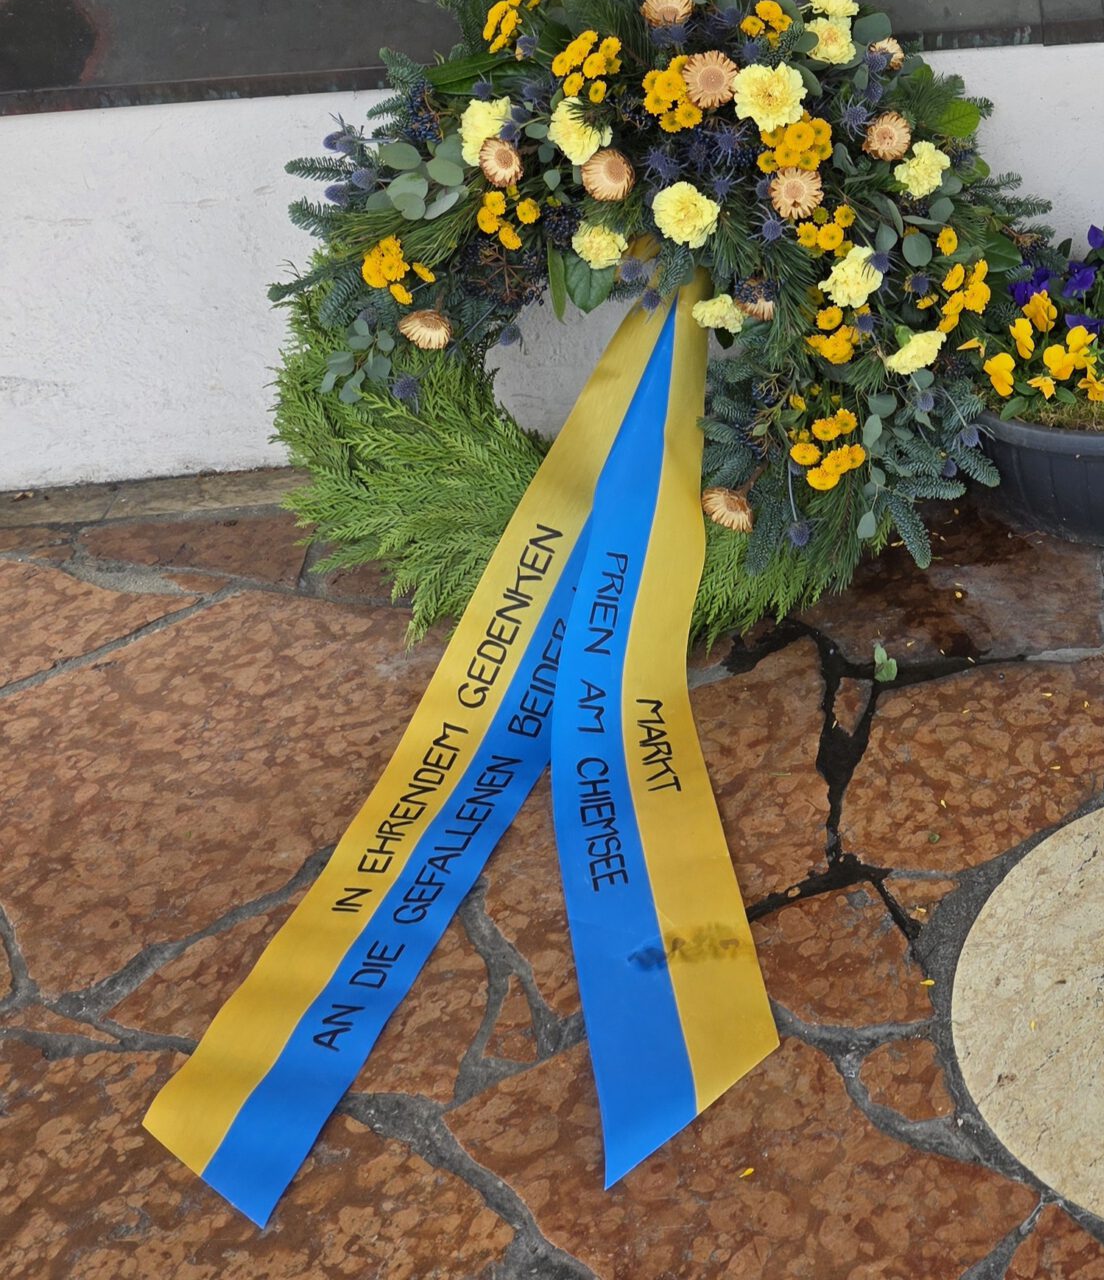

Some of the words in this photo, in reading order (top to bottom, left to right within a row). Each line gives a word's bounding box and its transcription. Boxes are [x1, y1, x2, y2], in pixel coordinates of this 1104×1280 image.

[583, 552, 628, 656] PRIEN
[332, 887, 374, 914] IN
[358, 722, 470, 875] EHRENDEM
[458, 524, 564, 708] GEDENKEN
[576, 679, 607, 734] AM
[636, 699, 683, 794] MARKT
[576, 757, 629, 893] CHIEMSEE
[313, 1004, 365, 1053] AN
[351, 939, 406, 990] DIE
[393, 755, 523, 924] GEFALLENEN
